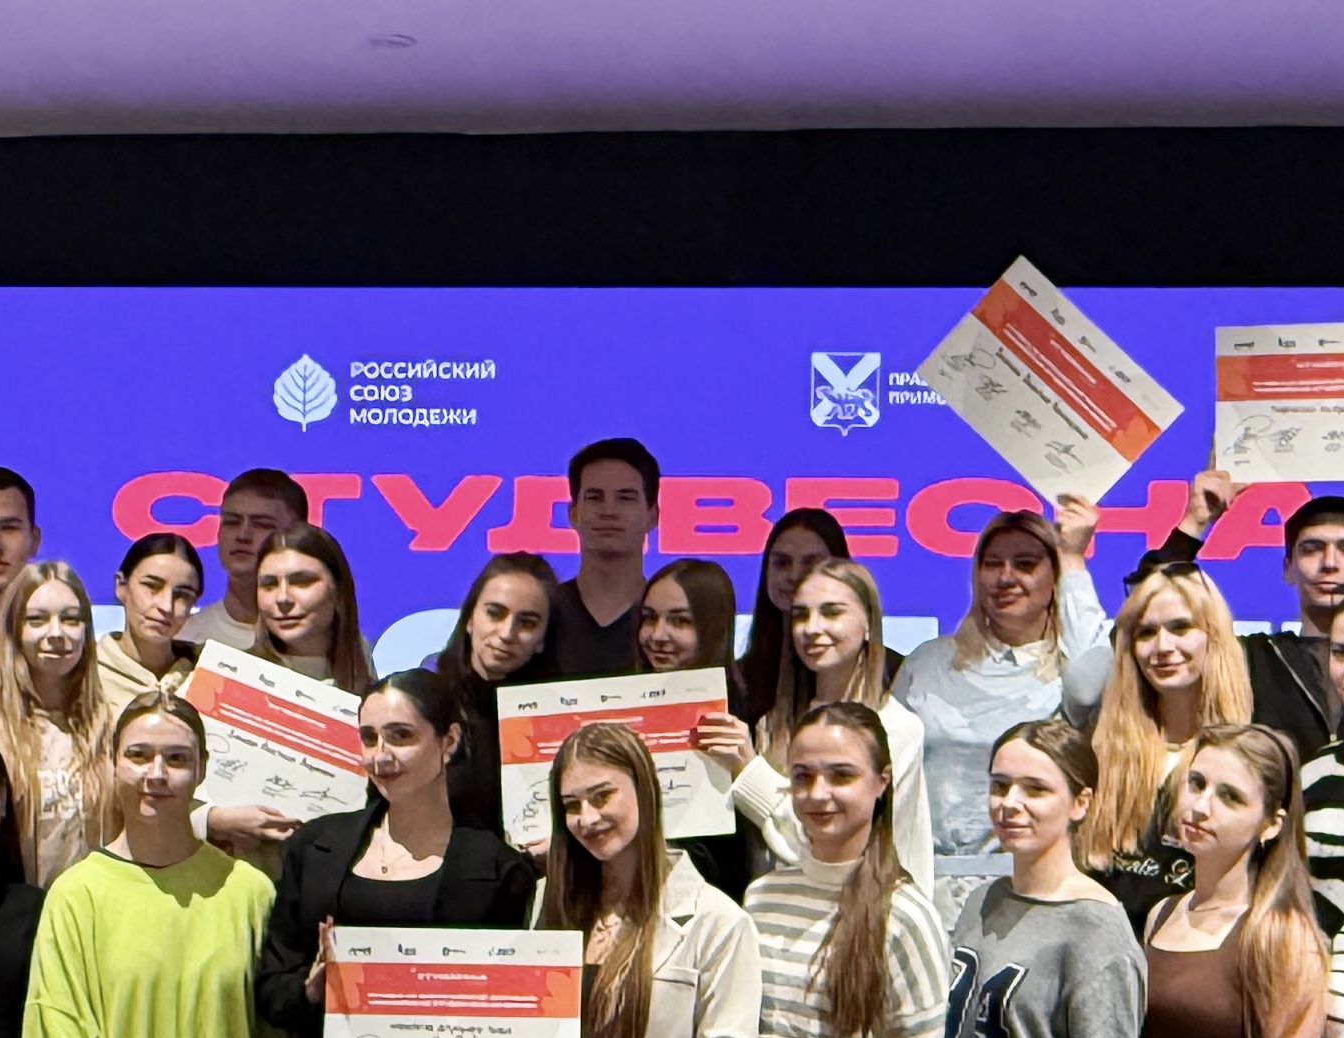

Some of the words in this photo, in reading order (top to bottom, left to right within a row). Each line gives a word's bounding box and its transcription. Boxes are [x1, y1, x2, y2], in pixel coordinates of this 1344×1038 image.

[350, 359, 496, 379] РОССИЙСКИЙ
[349, 384, 413, 402] СОЮЗ
[349, 408, 478, 427] МОЛОДЕЖИ
